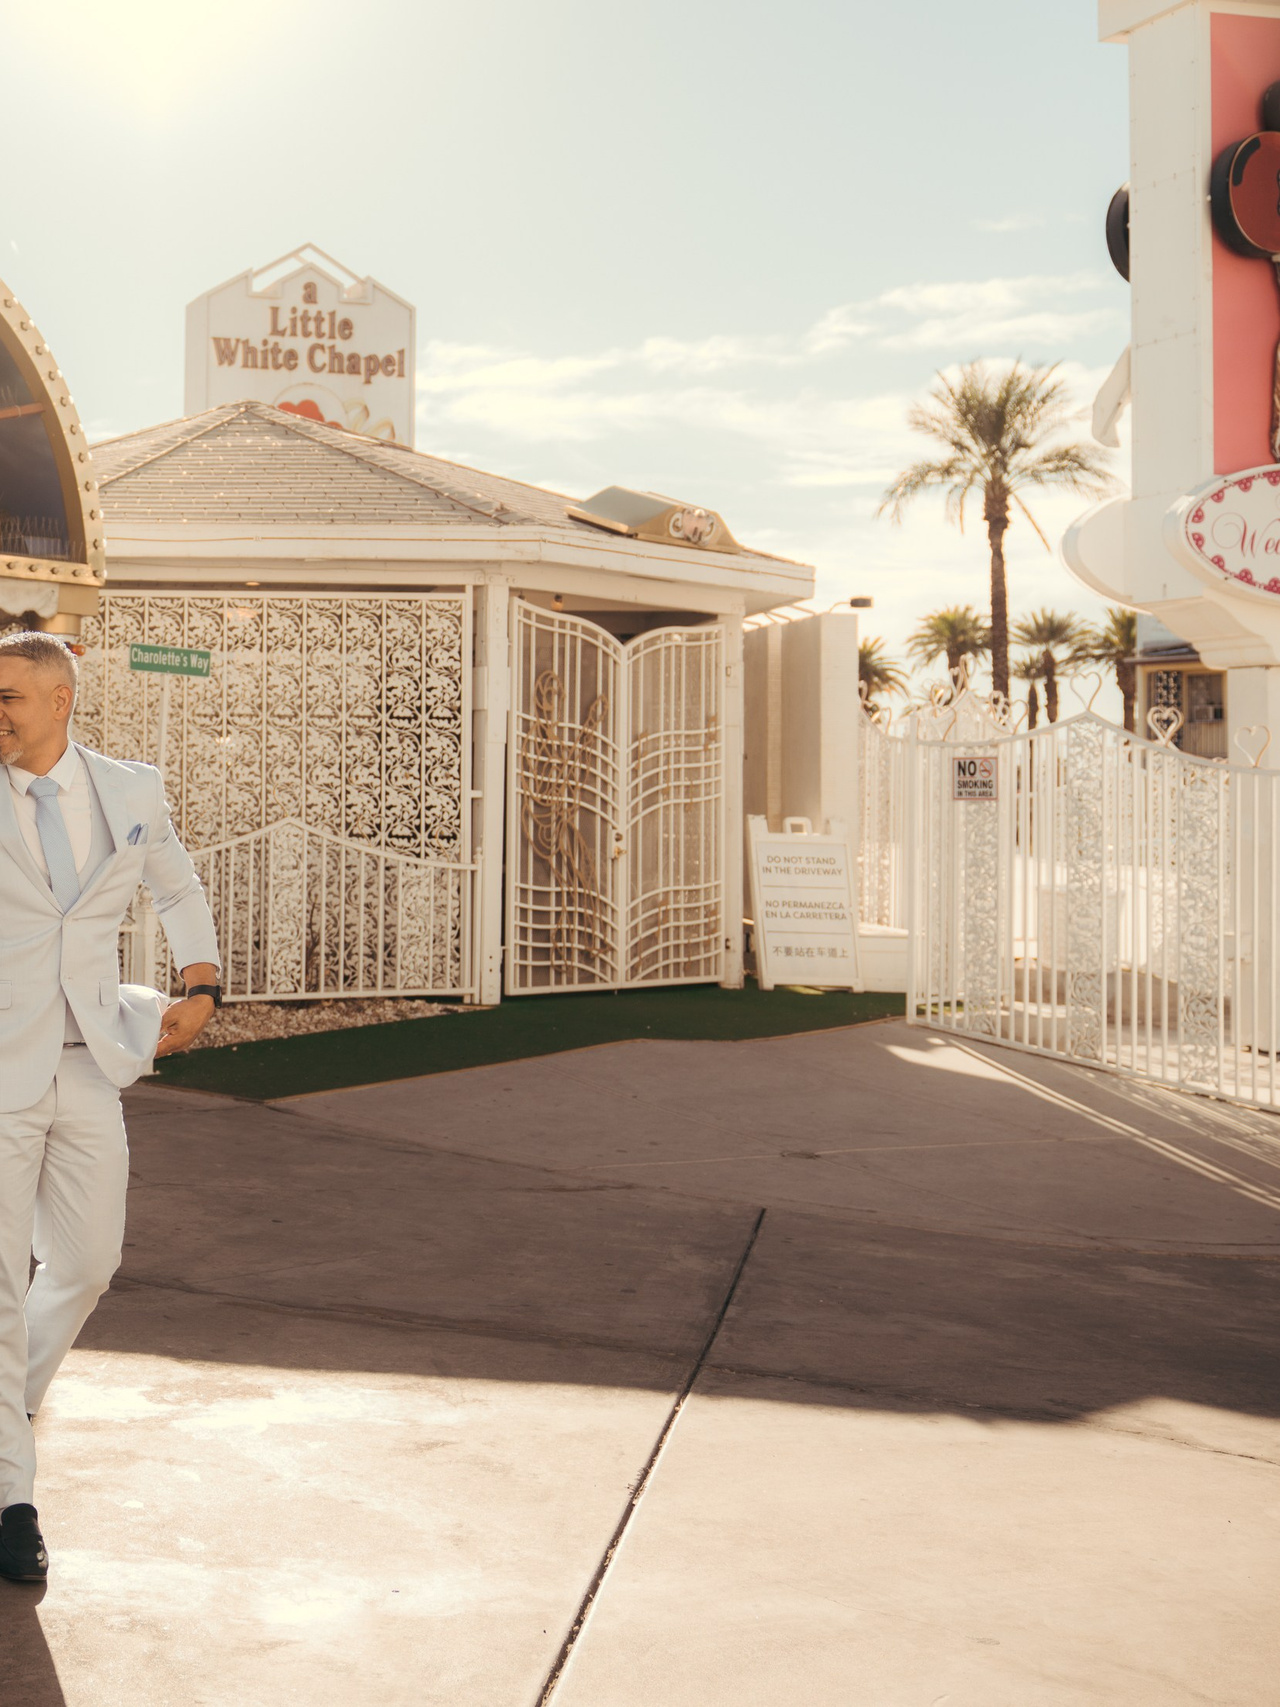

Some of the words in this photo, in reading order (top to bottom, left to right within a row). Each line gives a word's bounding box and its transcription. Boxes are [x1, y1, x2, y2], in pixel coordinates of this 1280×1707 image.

[302, 281, 318, 304] a
[269, 306, 354, 340] Little
[211, 337, 299, 371] White
[306, 343, 406, 385] Chapel
[131, 647, 188, 668] Charolette's
[190, 653, 209, 674] Way
[957, 760, 977, 777] NO
[957, 779, 993, 789] SMOKING
[766, 855, 781, 864] DO
[783, 855, 803, 865] NOT
[805, 856, 836, 865] STAND
[762, 866, 772, 874] IN
[774, 866, 792, 875] THE
[794, 867, 843, 876] DRIVEWAY
[765, 900, 780, 908] NO
[782, 900, 845, 910] PERMANEZCA
[765, 911, 778, 919] EN
[780, 911, 791, 919] LA
[793, 911, 847, 920] CARRETERA
